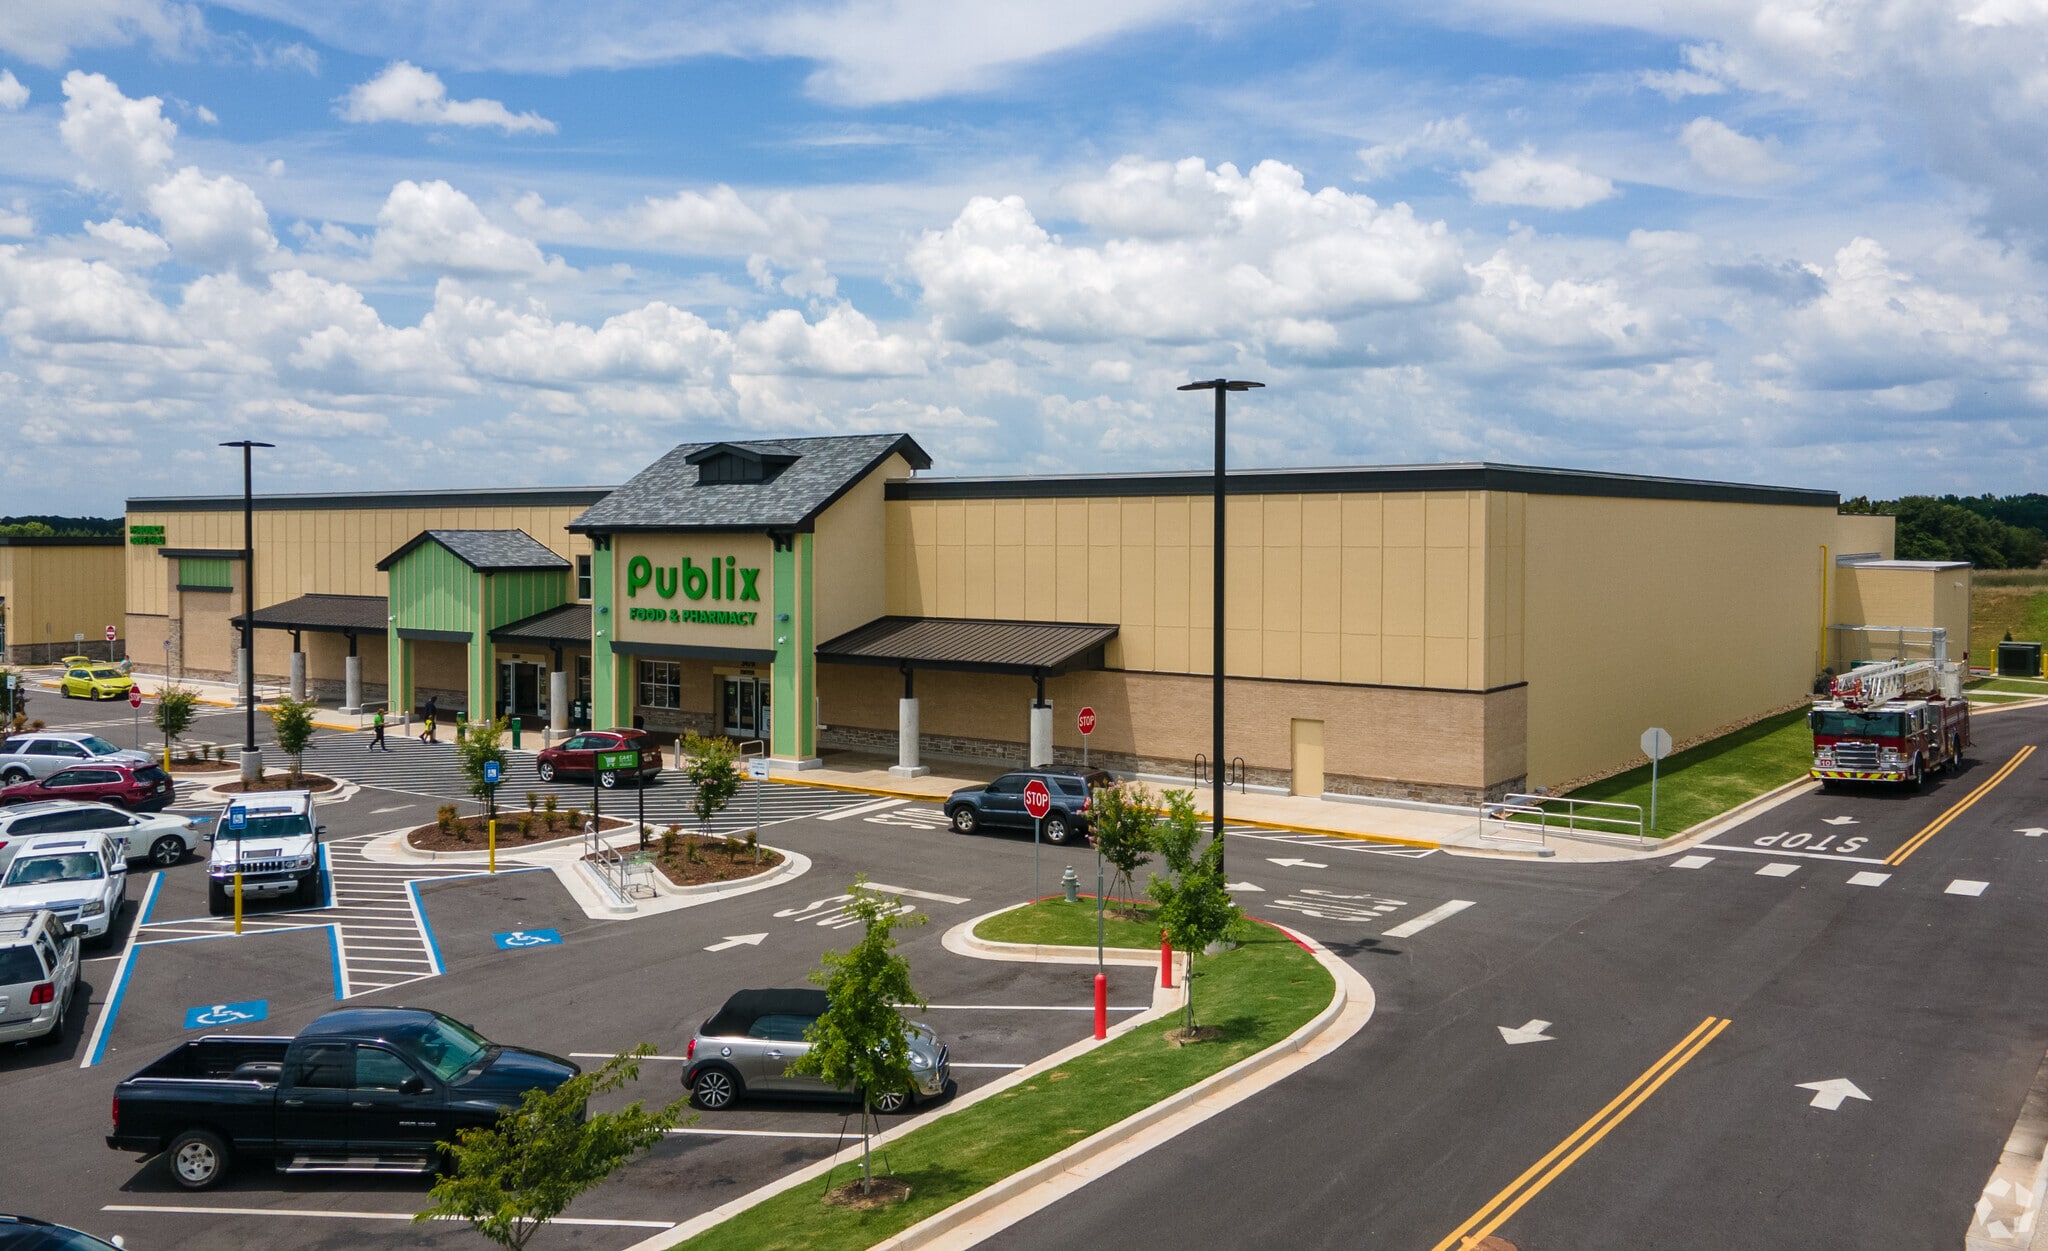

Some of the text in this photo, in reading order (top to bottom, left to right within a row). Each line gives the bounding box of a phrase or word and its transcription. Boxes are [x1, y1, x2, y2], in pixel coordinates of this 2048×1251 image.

[627, 555, 760, 601] Publix
[629, 607, 757, 626] FOOD & PHARMACY
[1079, 715, 1095, 727] STOP
[1026, 791, 1048, 807] STOP
[1753, 831, 1869, 853] STOP
